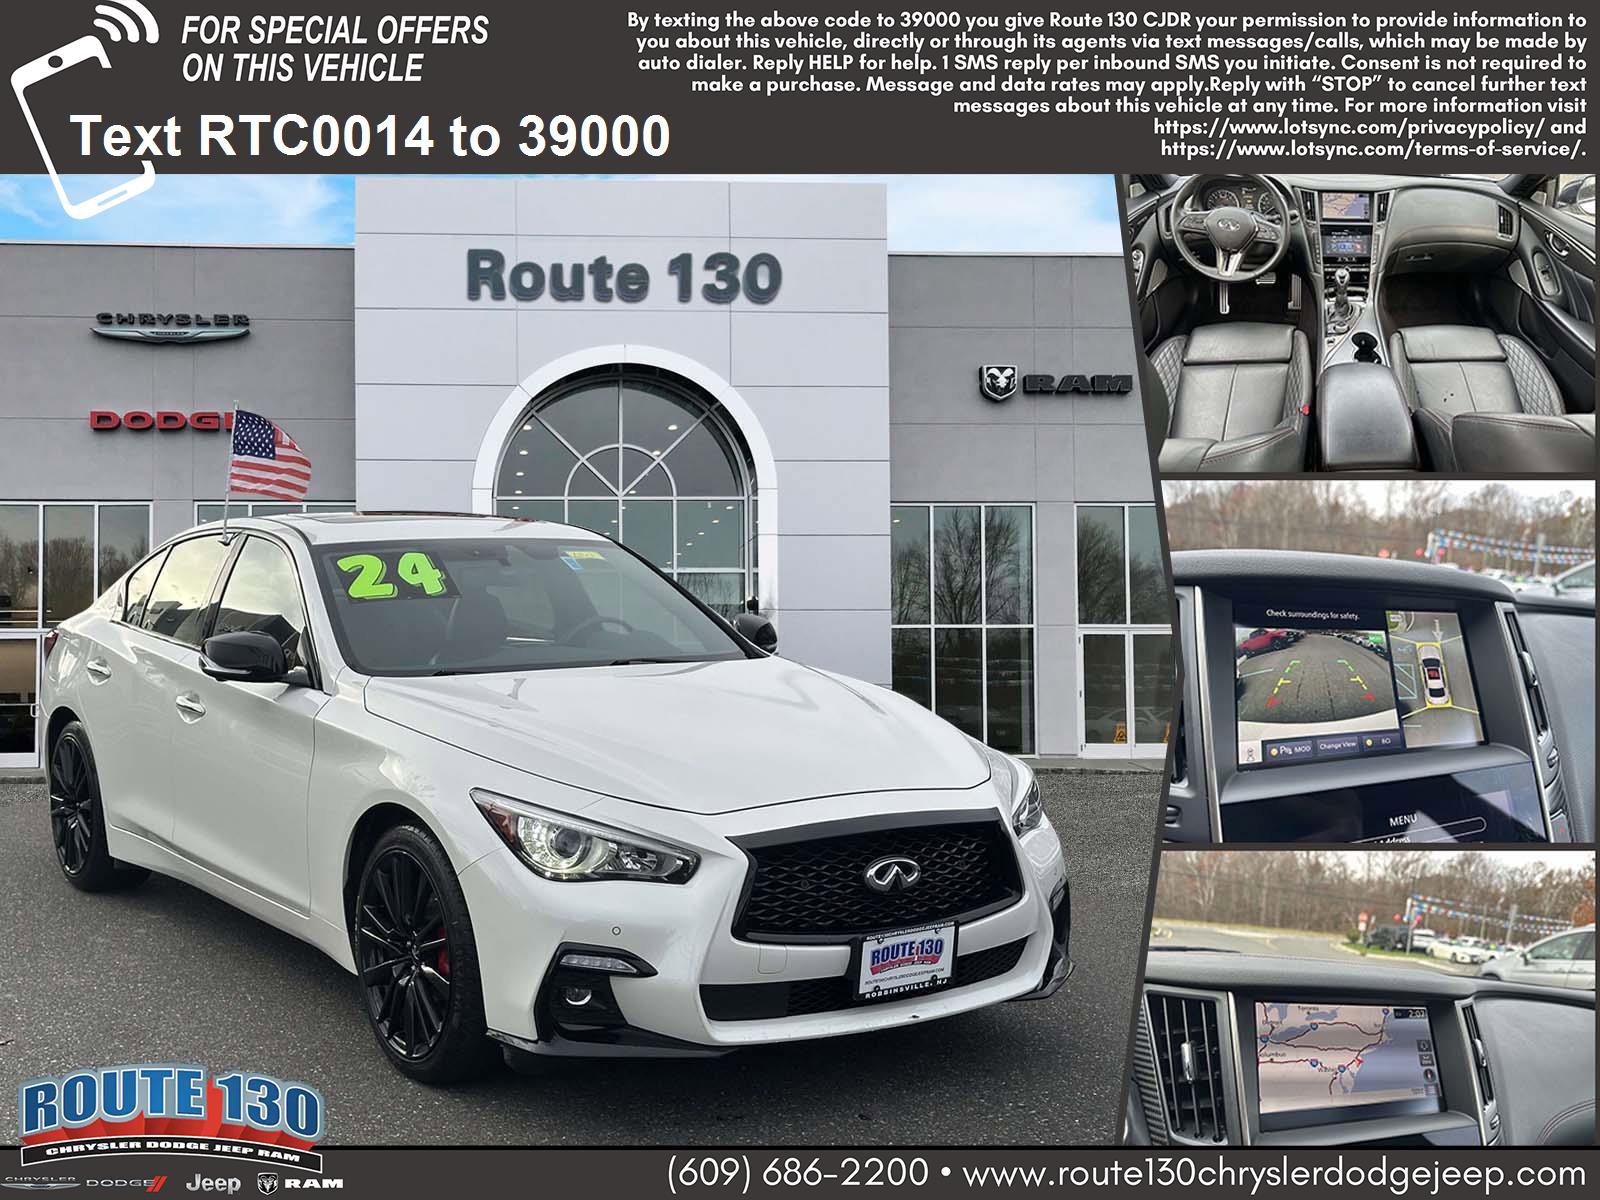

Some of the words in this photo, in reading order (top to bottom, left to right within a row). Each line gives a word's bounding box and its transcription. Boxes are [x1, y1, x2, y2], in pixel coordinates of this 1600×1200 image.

[467, 248, 650, 302] Route
[668, 251, 783, 304] 130
[95, 312, 250, 326] CHRYSLER
[1023, 374, 1133, 394] RAM
[337, 552, 447, 599] 24
[1266, 609, 1287, 618] Check
[1288, 611, 1330, 621] surroundings
[1330, 612, 1339, 620] for
[1340, 612, 1360, 622] safety.
[1319, 741, 1342, 751] Change
[1342, 741, 1357, 750] View
[1389, 813, 1418, 828] MENU
[871, 942, 916, 966] ROUTE
[918, 938, 944, 956] 130
[865, 980, 933, 999] ROBBINSVILLE,
